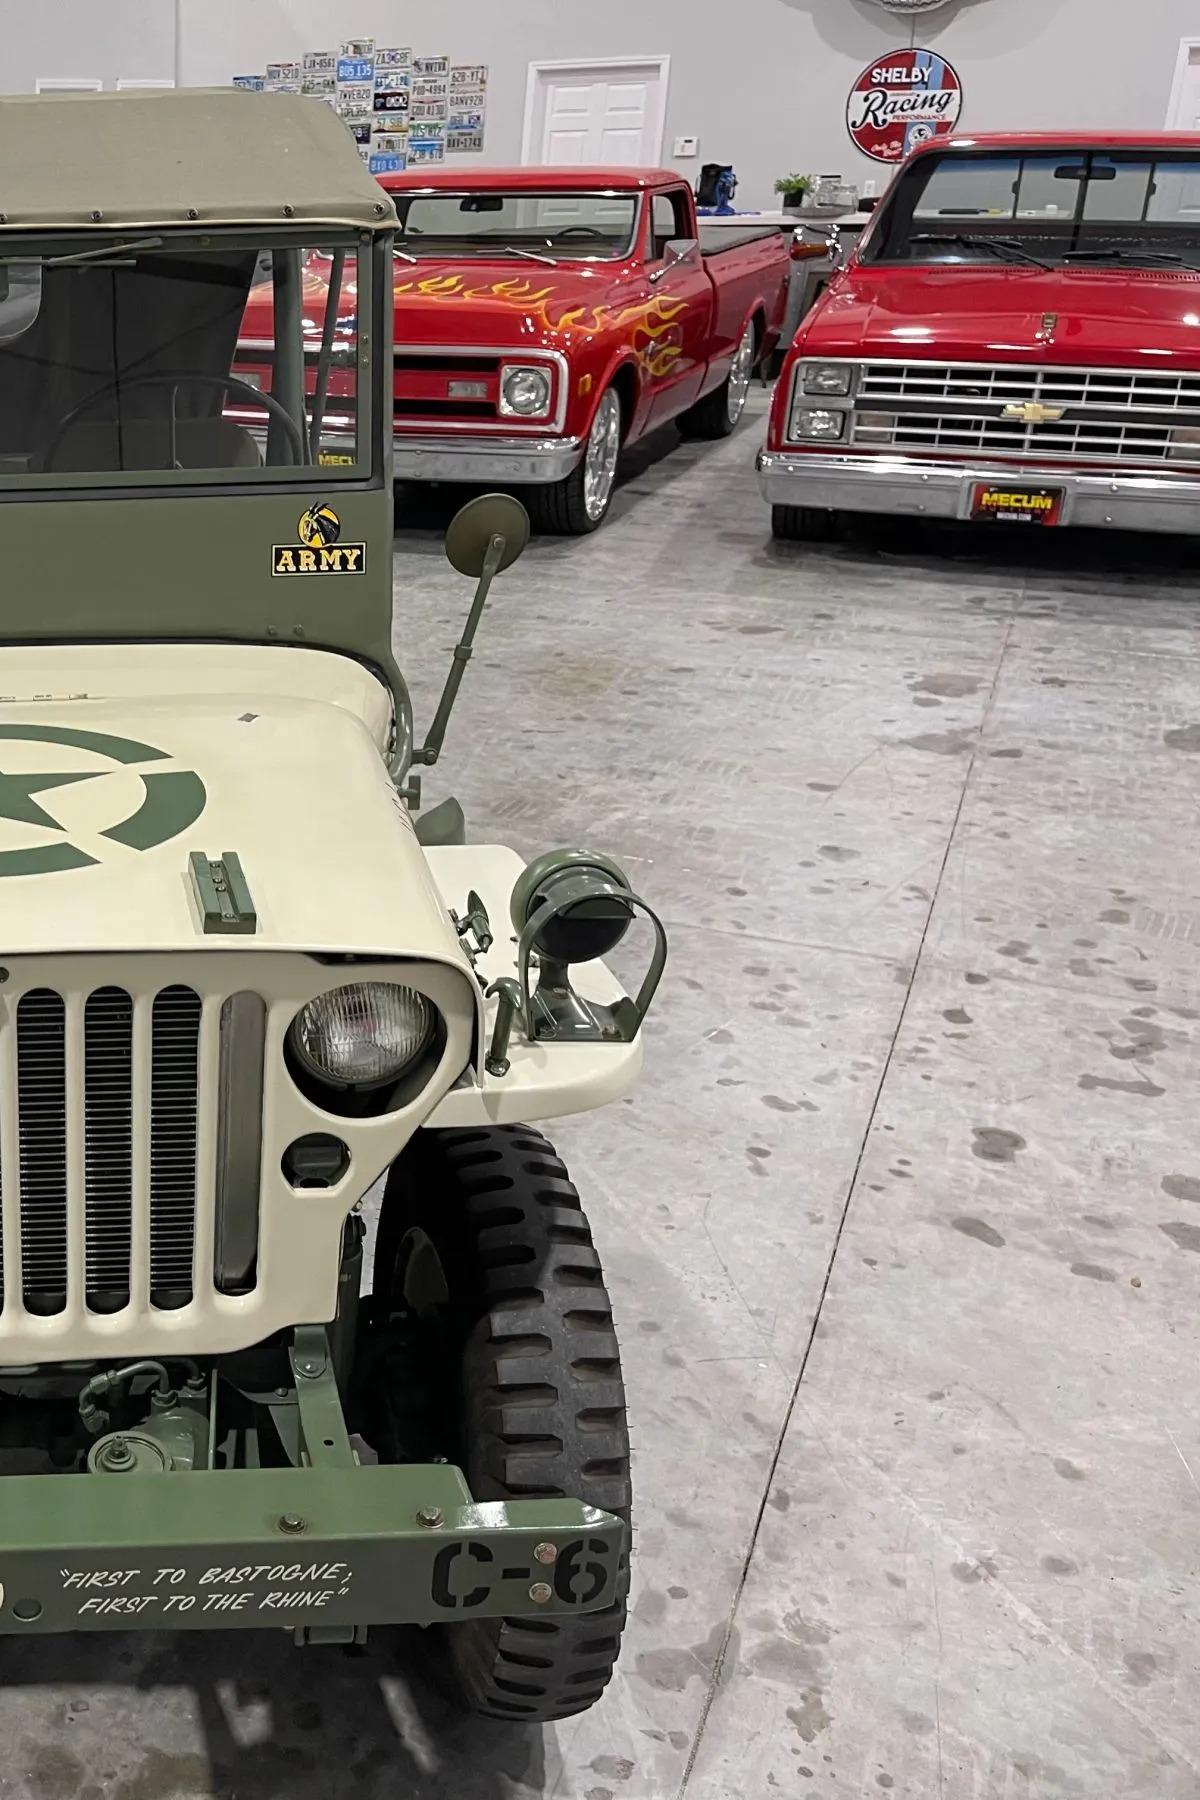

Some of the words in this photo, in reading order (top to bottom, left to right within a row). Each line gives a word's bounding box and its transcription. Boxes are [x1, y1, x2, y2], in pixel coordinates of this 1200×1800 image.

[871, 67, 933, 84] SHELBY
[851, 89, 953, 128] Racing
[981, 492, 1053, 510] MECUM
[276, 549, 361, 572] ARMY
[152, 1568, 187, 1585] TO
[431, 1538, 610, 1608] C-6
[77, 1596, 159, 1615] FIRST
[162, 1595, 197, 1612] TO
[202, 1592, 255, 1611] THE
